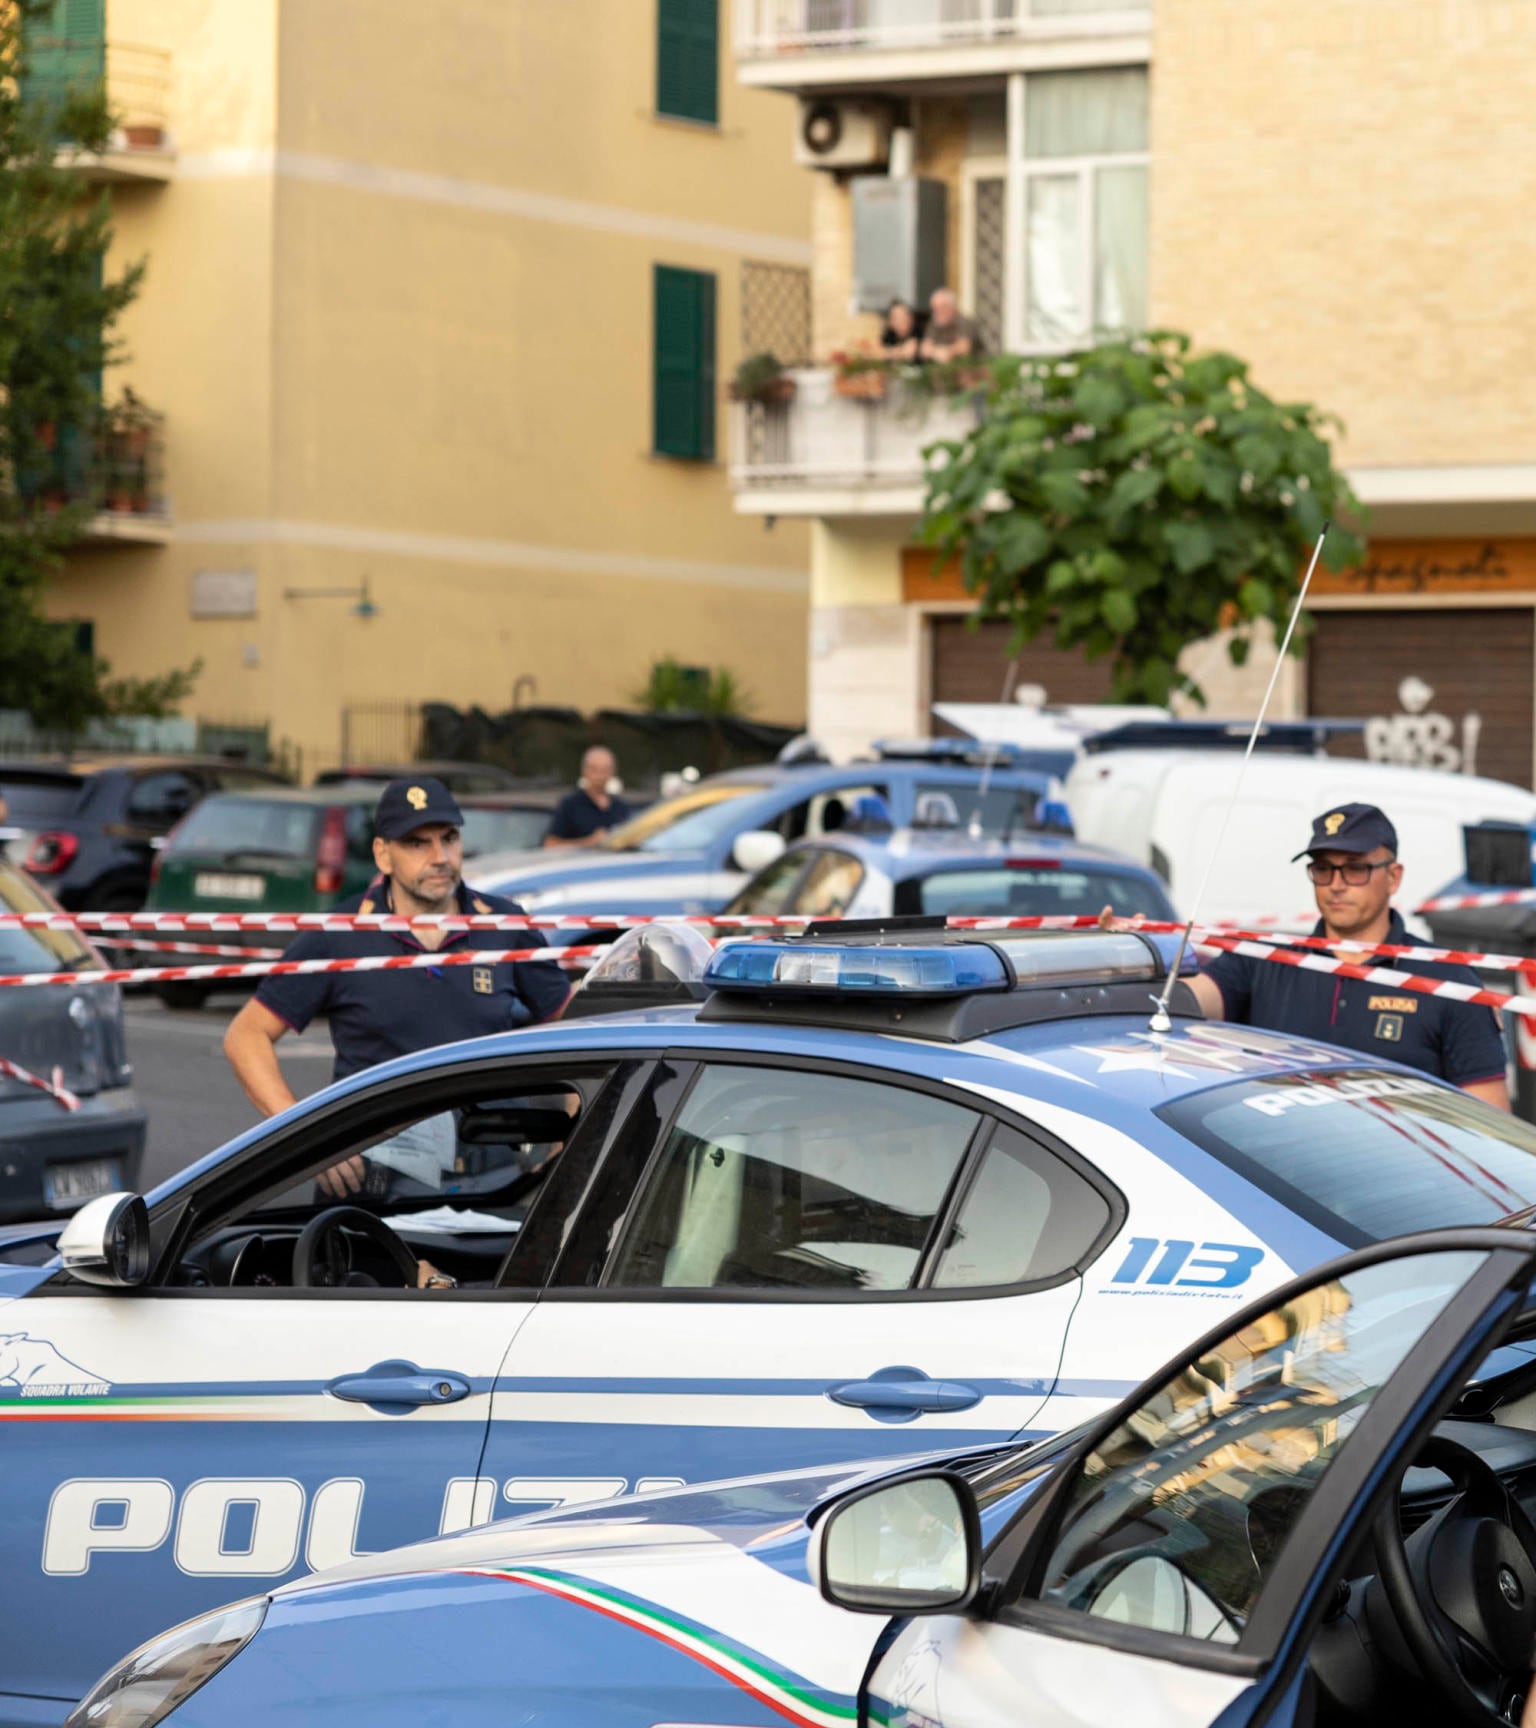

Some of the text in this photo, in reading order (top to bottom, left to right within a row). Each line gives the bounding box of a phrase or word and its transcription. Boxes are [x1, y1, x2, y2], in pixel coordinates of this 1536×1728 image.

[1111, 1237, 1265, 1288] 113
[21, 1383, 112, 1397] SQUADRA VOLANTE
